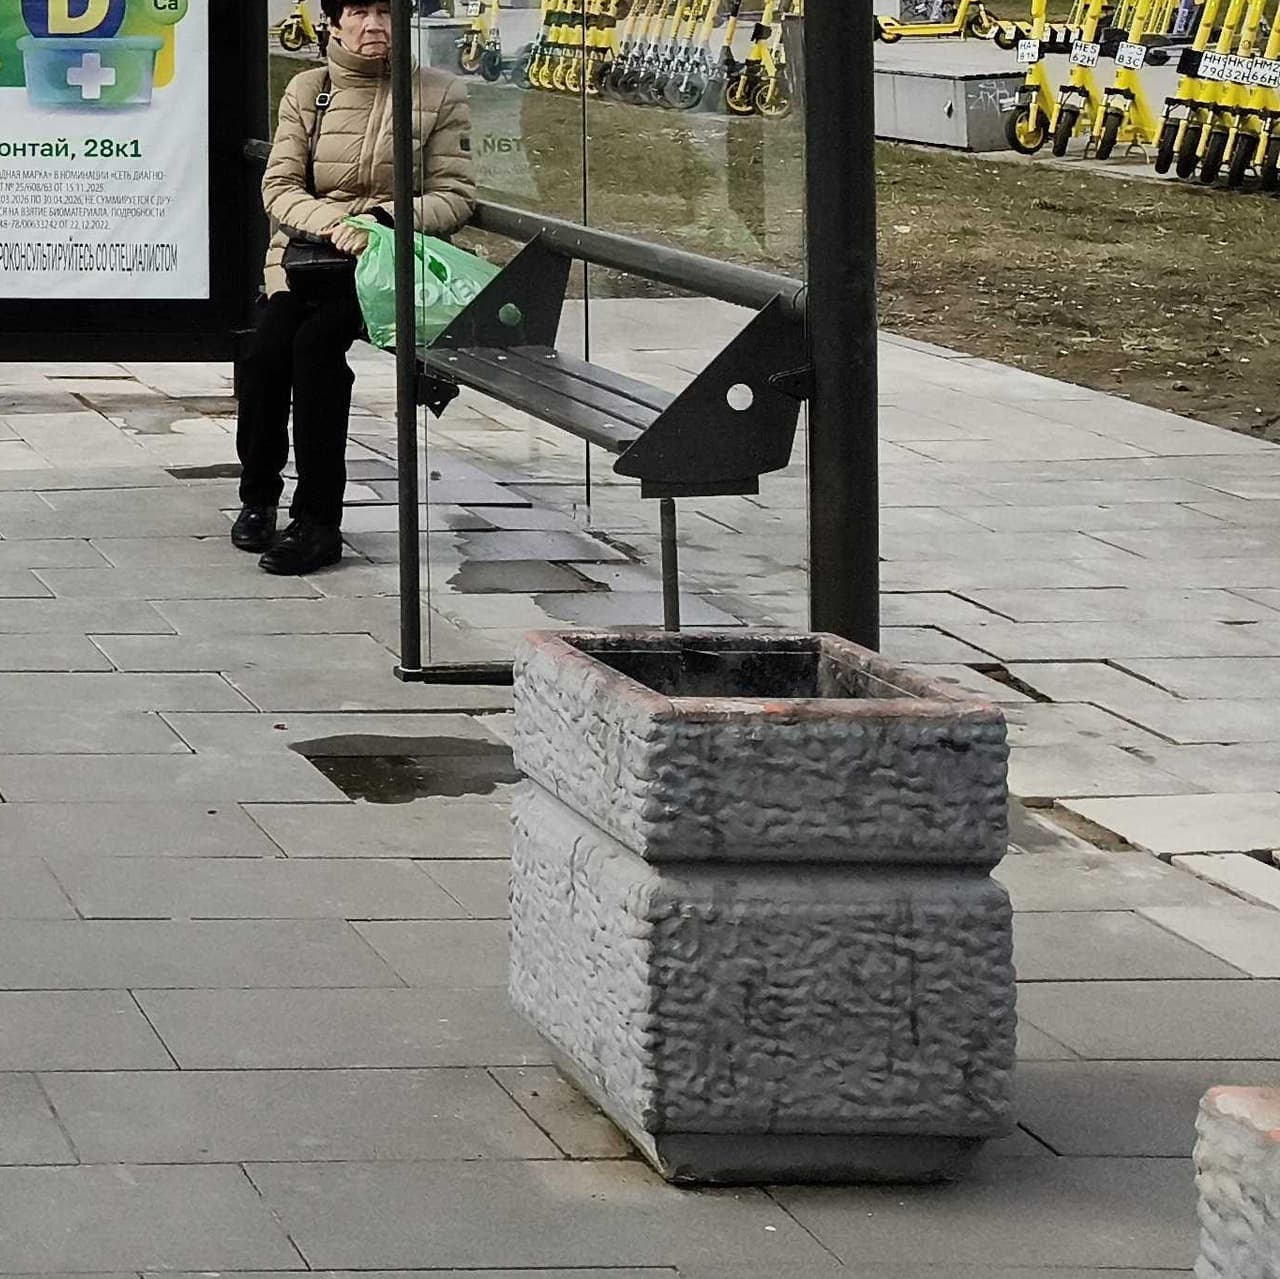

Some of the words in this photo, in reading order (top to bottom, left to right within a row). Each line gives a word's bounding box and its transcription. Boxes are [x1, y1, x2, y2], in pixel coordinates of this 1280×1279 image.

[84, 139, 142, 158] 28к1
[54, 183, 63, 192] ОТ
[85, 195, 95, 204] НЕ
[10, 207, 19, 216] НА
[95, 243, 108, 271] СО
[109, 243, 178, 276] СПЕЦИАЛИСТОМ
